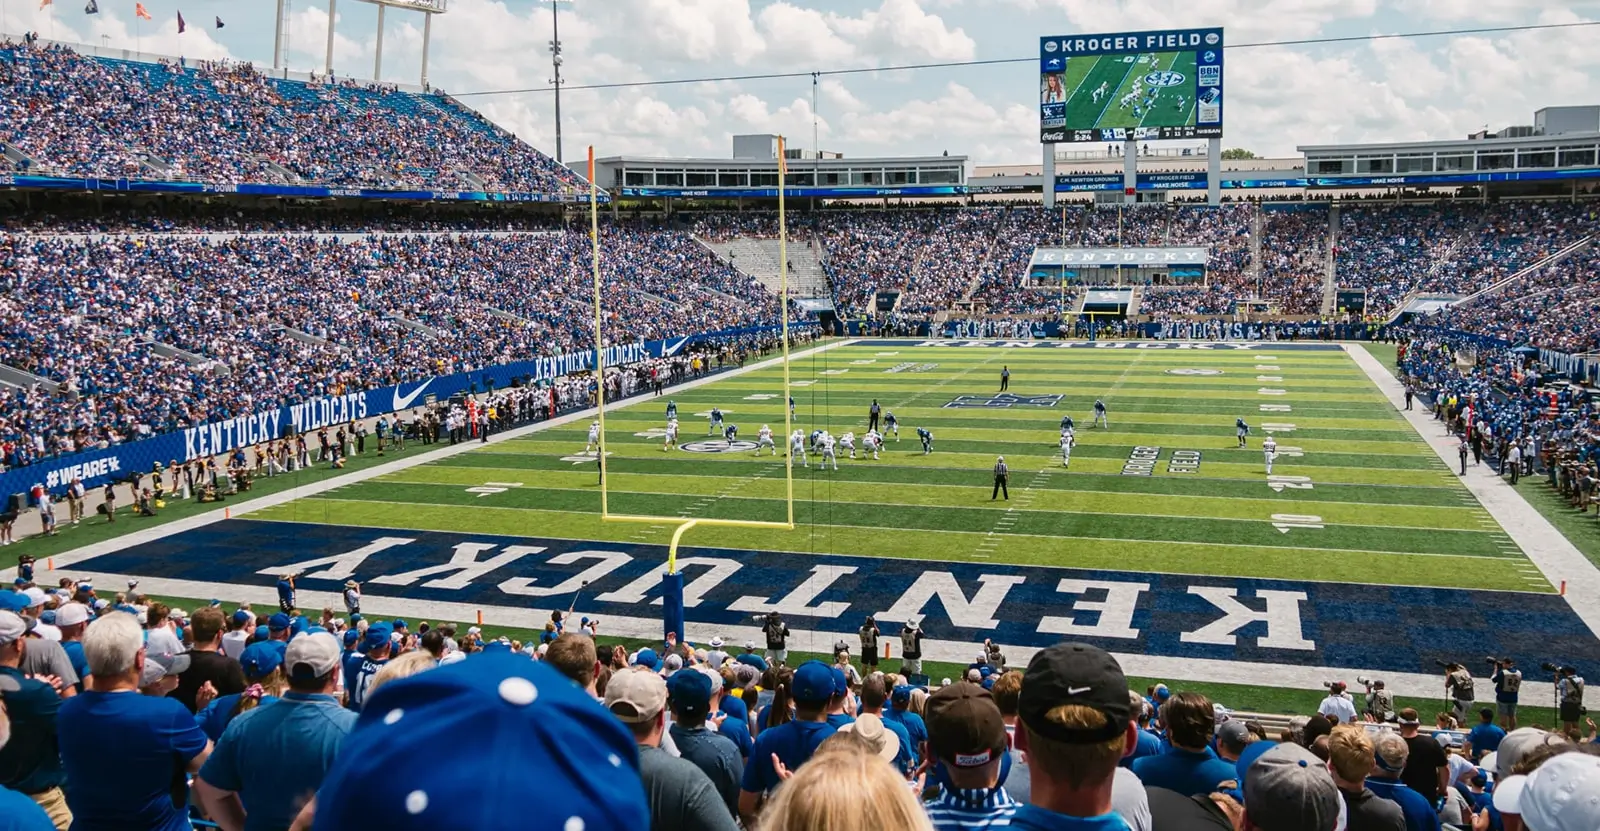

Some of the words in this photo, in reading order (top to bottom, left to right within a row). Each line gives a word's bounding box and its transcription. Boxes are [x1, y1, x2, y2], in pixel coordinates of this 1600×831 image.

[1062, 37, 1138, 52] KROGER
[1147, 33, 1200, 48] FIELD
[0, 176, 16, 185] ISE
[214, 184, 237, 192] DOWN
[1042, 252, 1198, 261] KENTUCKY
[913, 340, 1260, 350] KENTUCKY
[534, 349, 592, 380] KENTUCKY
[184, 409, 281, 461] KENTUCKY
[289, 391, 368, 433] WILDCATS
[1271, 513, 1324, 529] 10
[255, 537, 1316, 651] KENTUCKY
